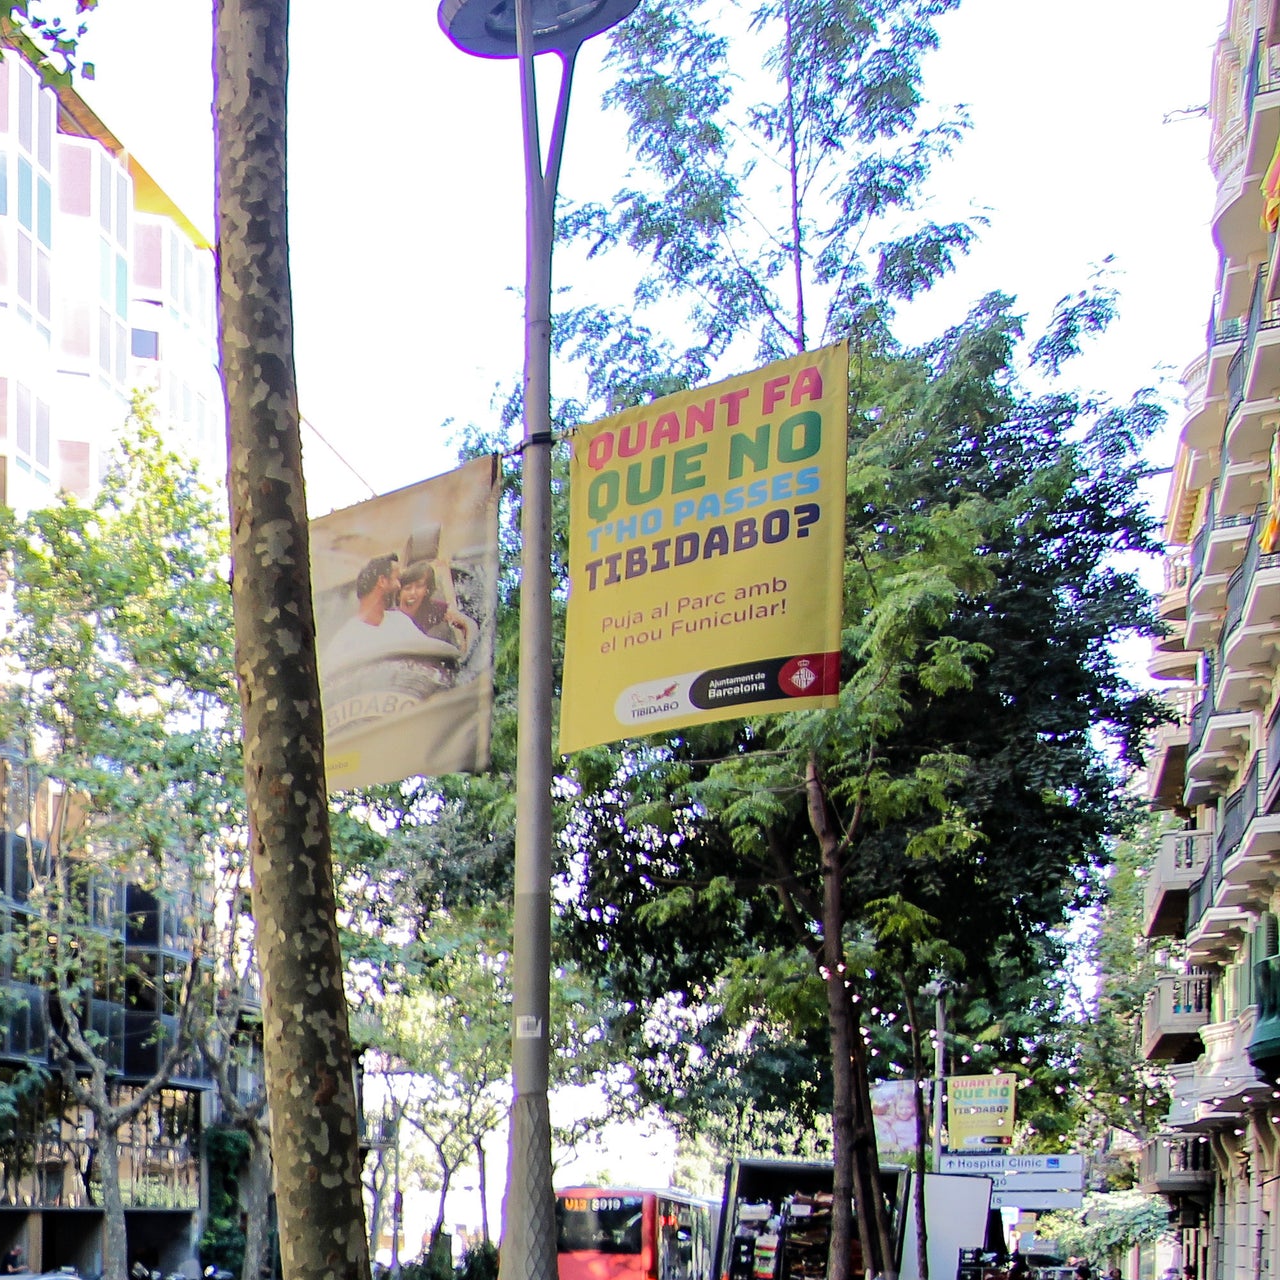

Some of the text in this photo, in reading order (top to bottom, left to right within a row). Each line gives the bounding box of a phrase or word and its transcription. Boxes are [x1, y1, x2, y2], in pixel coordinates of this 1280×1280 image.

[588, 366, 823, 471] QUANT FA
[588, 410, 822, 523] QUE NO
[586, 466, 821, 552] T'HO PASSES
[585, 502, 821, 591] TIBIDABO?
[601, 576, 788, 633] Puja al Parc amb
[600, 599, 788, 654] el nou Funicular!
[708, 682, 766, 699] Barcelona
[709, 671, 766, 689] Ajuntament de
[631, 700, 680, 718] TIBIDABO
[954, 1087, 1010, 1100] QUE NO
[954, 1105, 1009, 1115] TIBDABO?
[957, 1158, 1043, 1170] Hospital Clinic
